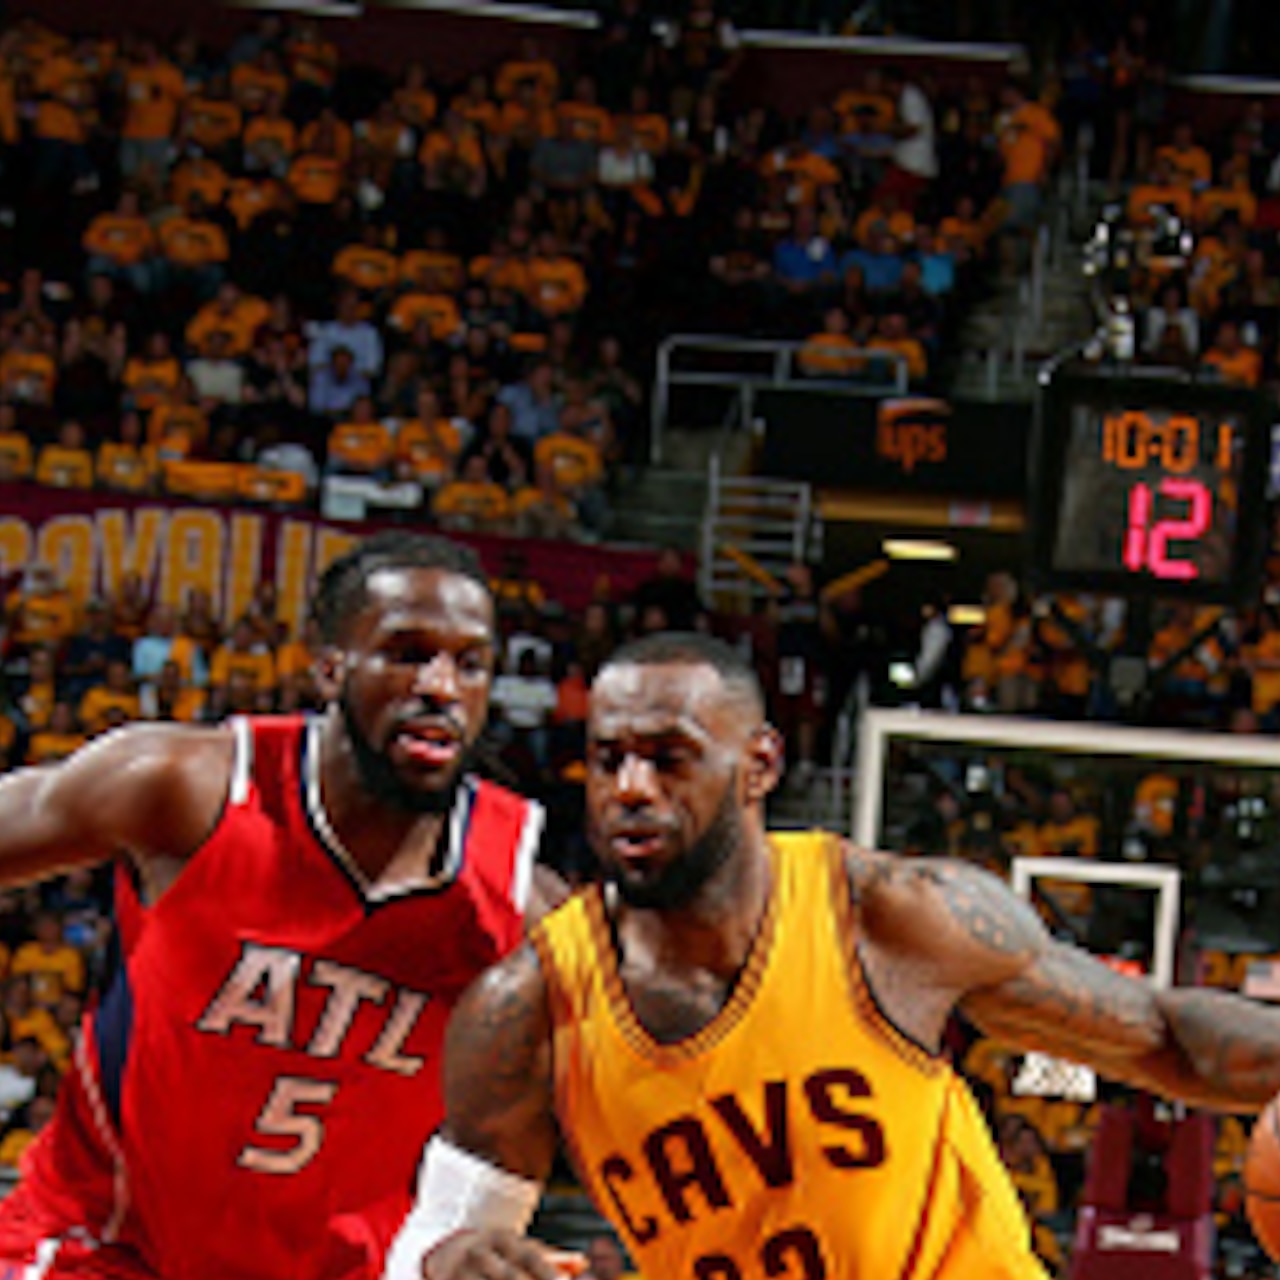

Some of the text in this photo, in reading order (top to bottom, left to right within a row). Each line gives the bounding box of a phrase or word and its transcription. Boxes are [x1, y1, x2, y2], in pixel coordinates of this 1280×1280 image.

[877, 416, 947, 475] ups
[1102, 411, 1232, 473] 10:01
[1122, 477, 1213, 581] 12
[195, 941, 431, 1077] ATL
[235, 1076, 340, 1175] 5
[601, 1067, 889, 1245] CAVS
